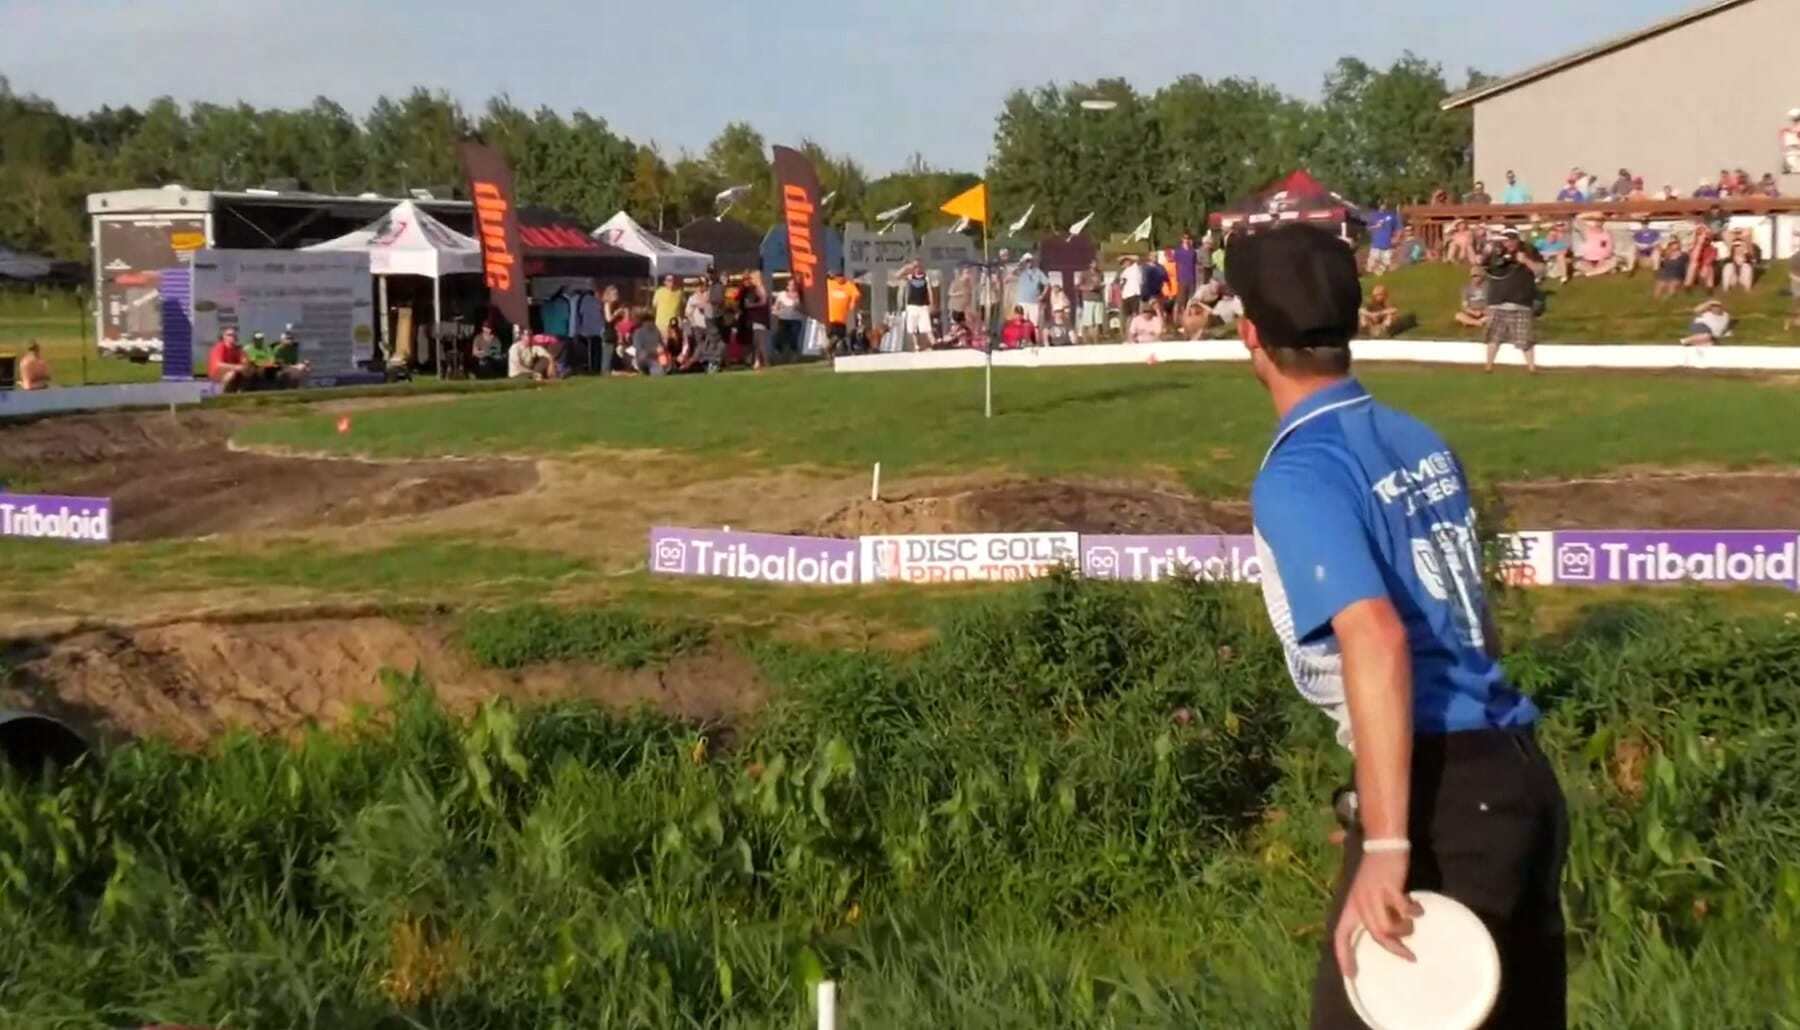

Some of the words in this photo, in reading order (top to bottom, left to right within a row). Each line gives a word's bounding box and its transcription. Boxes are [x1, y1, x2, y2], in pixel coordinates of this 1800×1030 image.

[474, 182, 515, 291] dude
[783, 185, 818, 288] dude
[0, 503, 108, 540] Tribaloid
[691, 539, 855, 584] Tribaloid
[906, 539, 977, 562] DISC
[988, 537, 1067, 561] GOLF
[1125, 546, 1262, 583] Tribalo
[1600, 540, 1795, 581] Tribaloid
